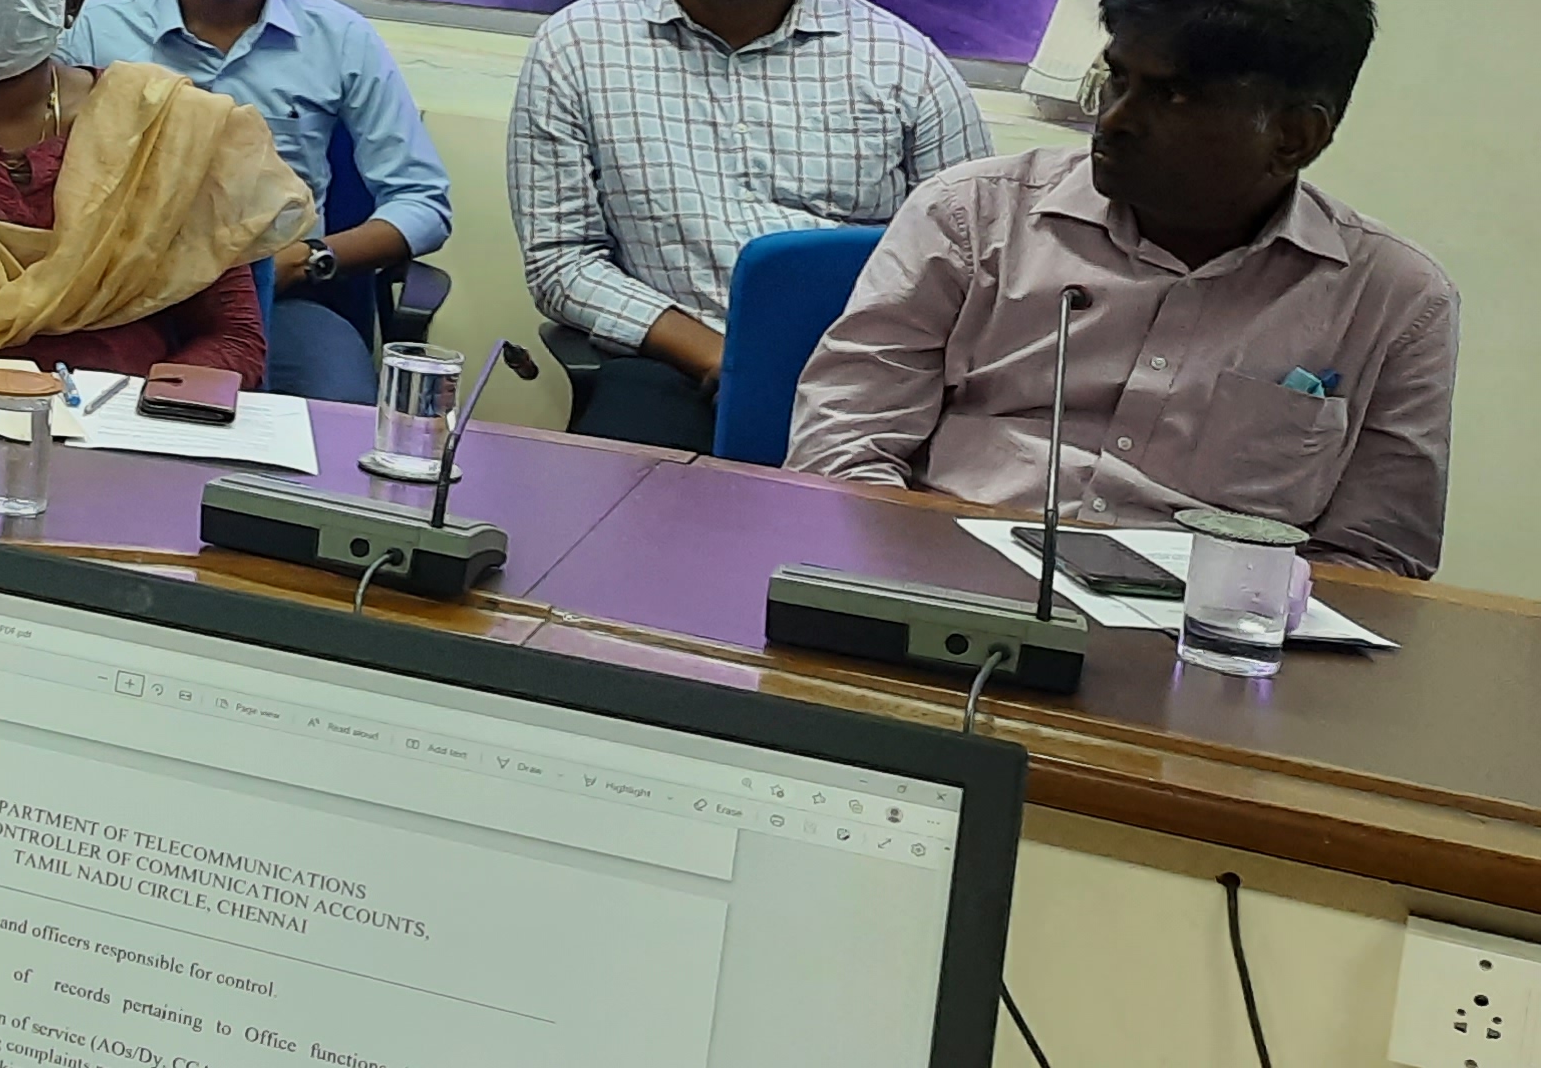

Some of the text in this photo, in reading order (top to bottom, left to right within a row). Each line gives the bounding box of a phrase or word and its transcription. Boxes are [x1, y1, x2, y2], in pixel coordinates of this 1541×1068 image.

[427, 744, 448, 756] Add
[517, 761, 542, 776] Draw
[605, 780, 652, 800] Highlight
[716, 802, 744, 818] Erase
[102, 823, 129, 844] OF
[133, 831, 368, 901] TELECOMMUNICATIONS
[13, 848, 309, 935] TAMIL NADU CIRCLE, CHENNAI
[106, 846, 132, 868] OF
[136, 855, 310, 911] COMMUNICATION
[313, 896, 431, 942] ACCOUNTS,
[0, 916, 28, 935] and
[31, 924, 90, 951] officers
[94, 940, 185, 975] responsible
[190, 962, 214, 982] for
[11, 1015, 31, 1032] of
[31, 1021, 87, 1048] service
[13, 967, 34, 984] of
[53, 979, 111, 1005] records
[122, 998, 204, 1033] pertaining
[216, 1019, 232, 1036] to
[244, 1026, 297, 1053] Office
